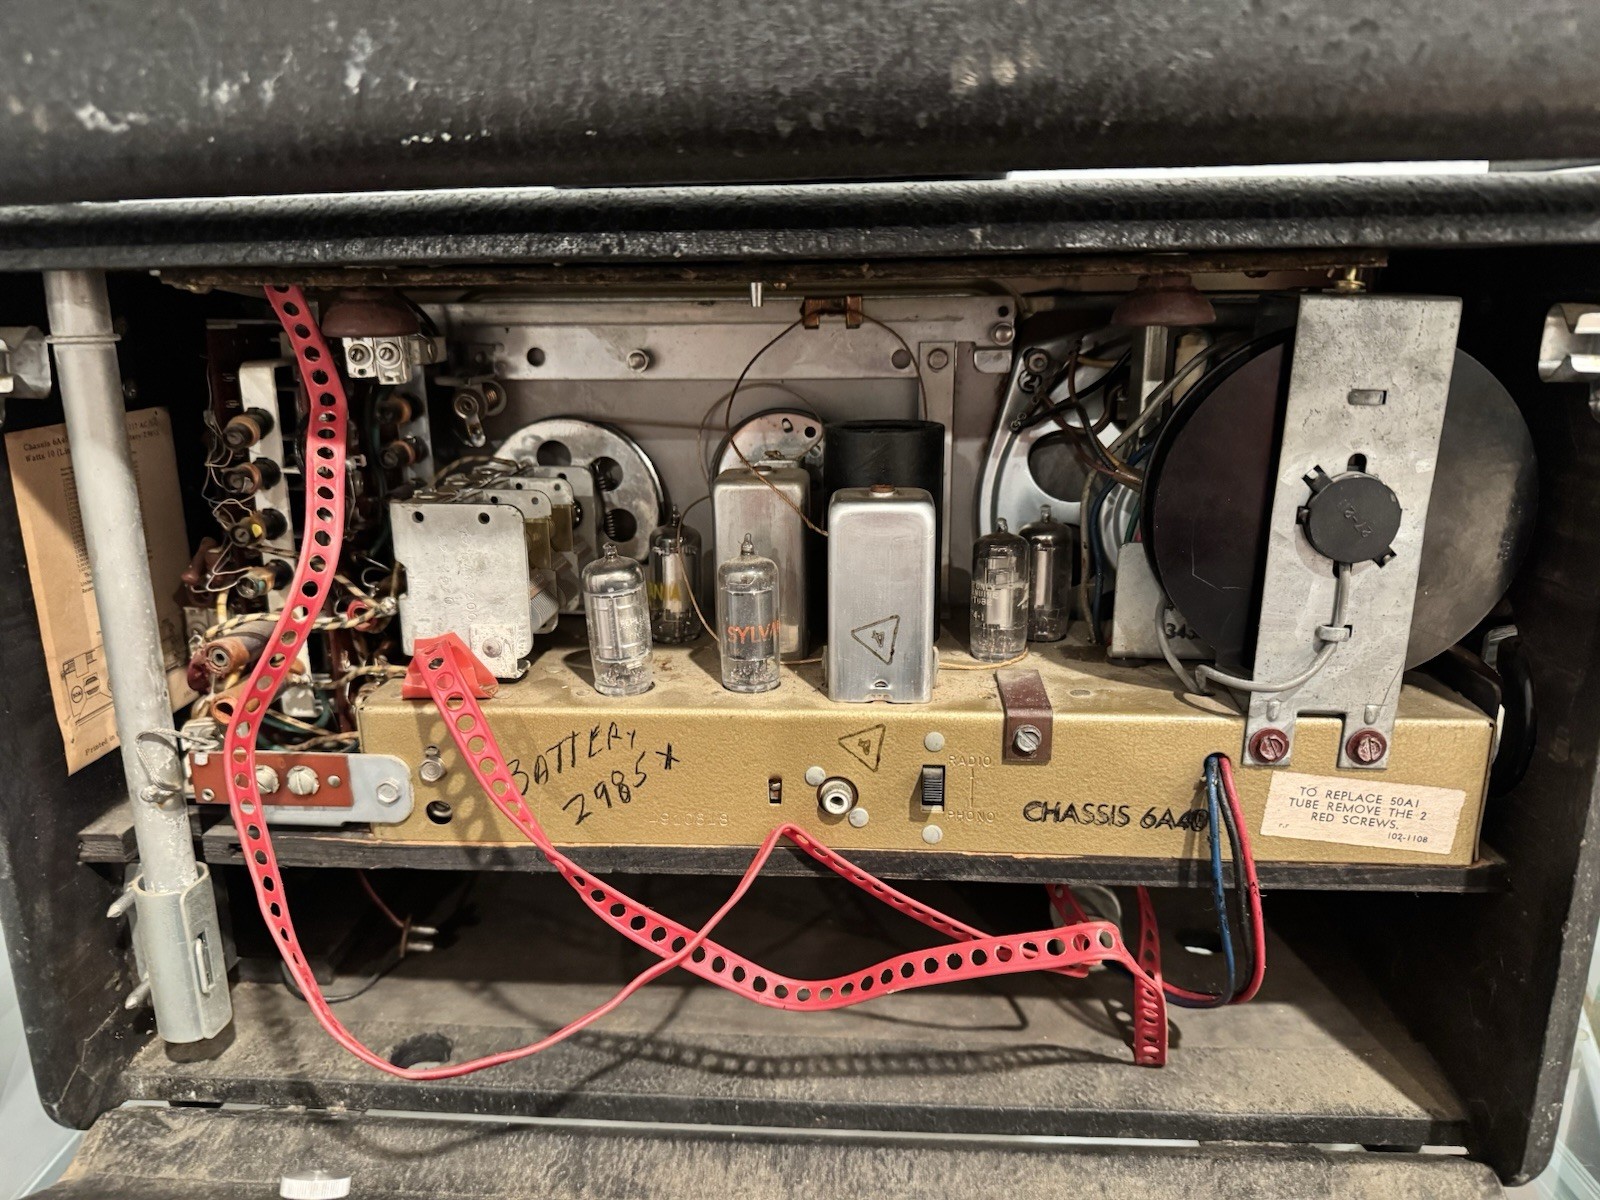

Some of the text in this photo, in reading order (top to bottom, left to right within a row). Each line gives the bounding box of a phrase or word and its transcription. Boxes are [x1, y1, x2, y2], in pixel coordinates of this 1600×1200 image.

[25, 452, 45, 463] Watts
[948, 754, 992, 768] RADIO
[1300, 786, 1419, 808] TO REPLACE 50A1
[946, 810, 995, 823] PHONO
[1023, 800, 1131, 828] CHASSIS
[1289, 797, 1427, 821] TUBE REMOVE THE 2
[1311, 812, 1399, 830] RED SCREWS.
